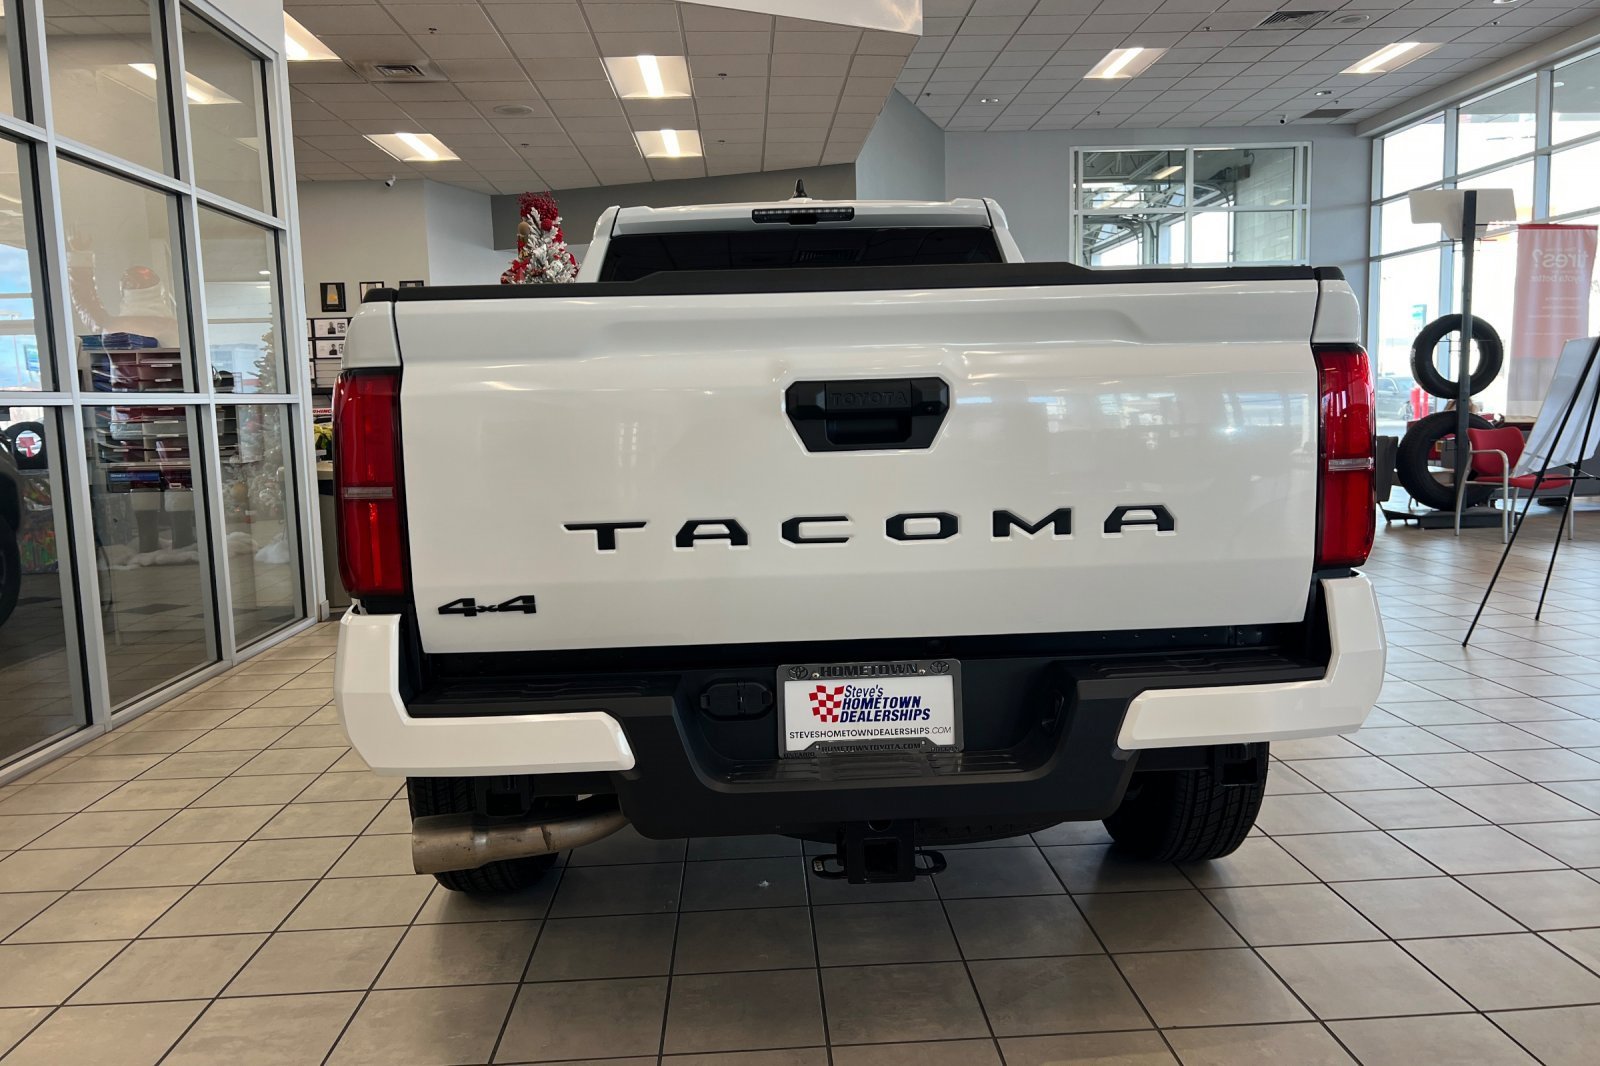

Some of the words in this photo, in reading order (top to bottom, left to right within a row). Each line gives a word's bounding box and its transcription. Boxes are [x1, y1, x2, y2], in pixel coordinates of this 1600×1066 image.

[830, 391, 908, 407] TOYOTA
[563, 503, 1176, 551] TACOMA
[820, 663, 918, 678] HOMETOWN
[844, 684, 884, 698] Steve's
[842, 695, 922, 710] HOMETOWN
[839, 708, 931, 723] DEALERSHIPS
